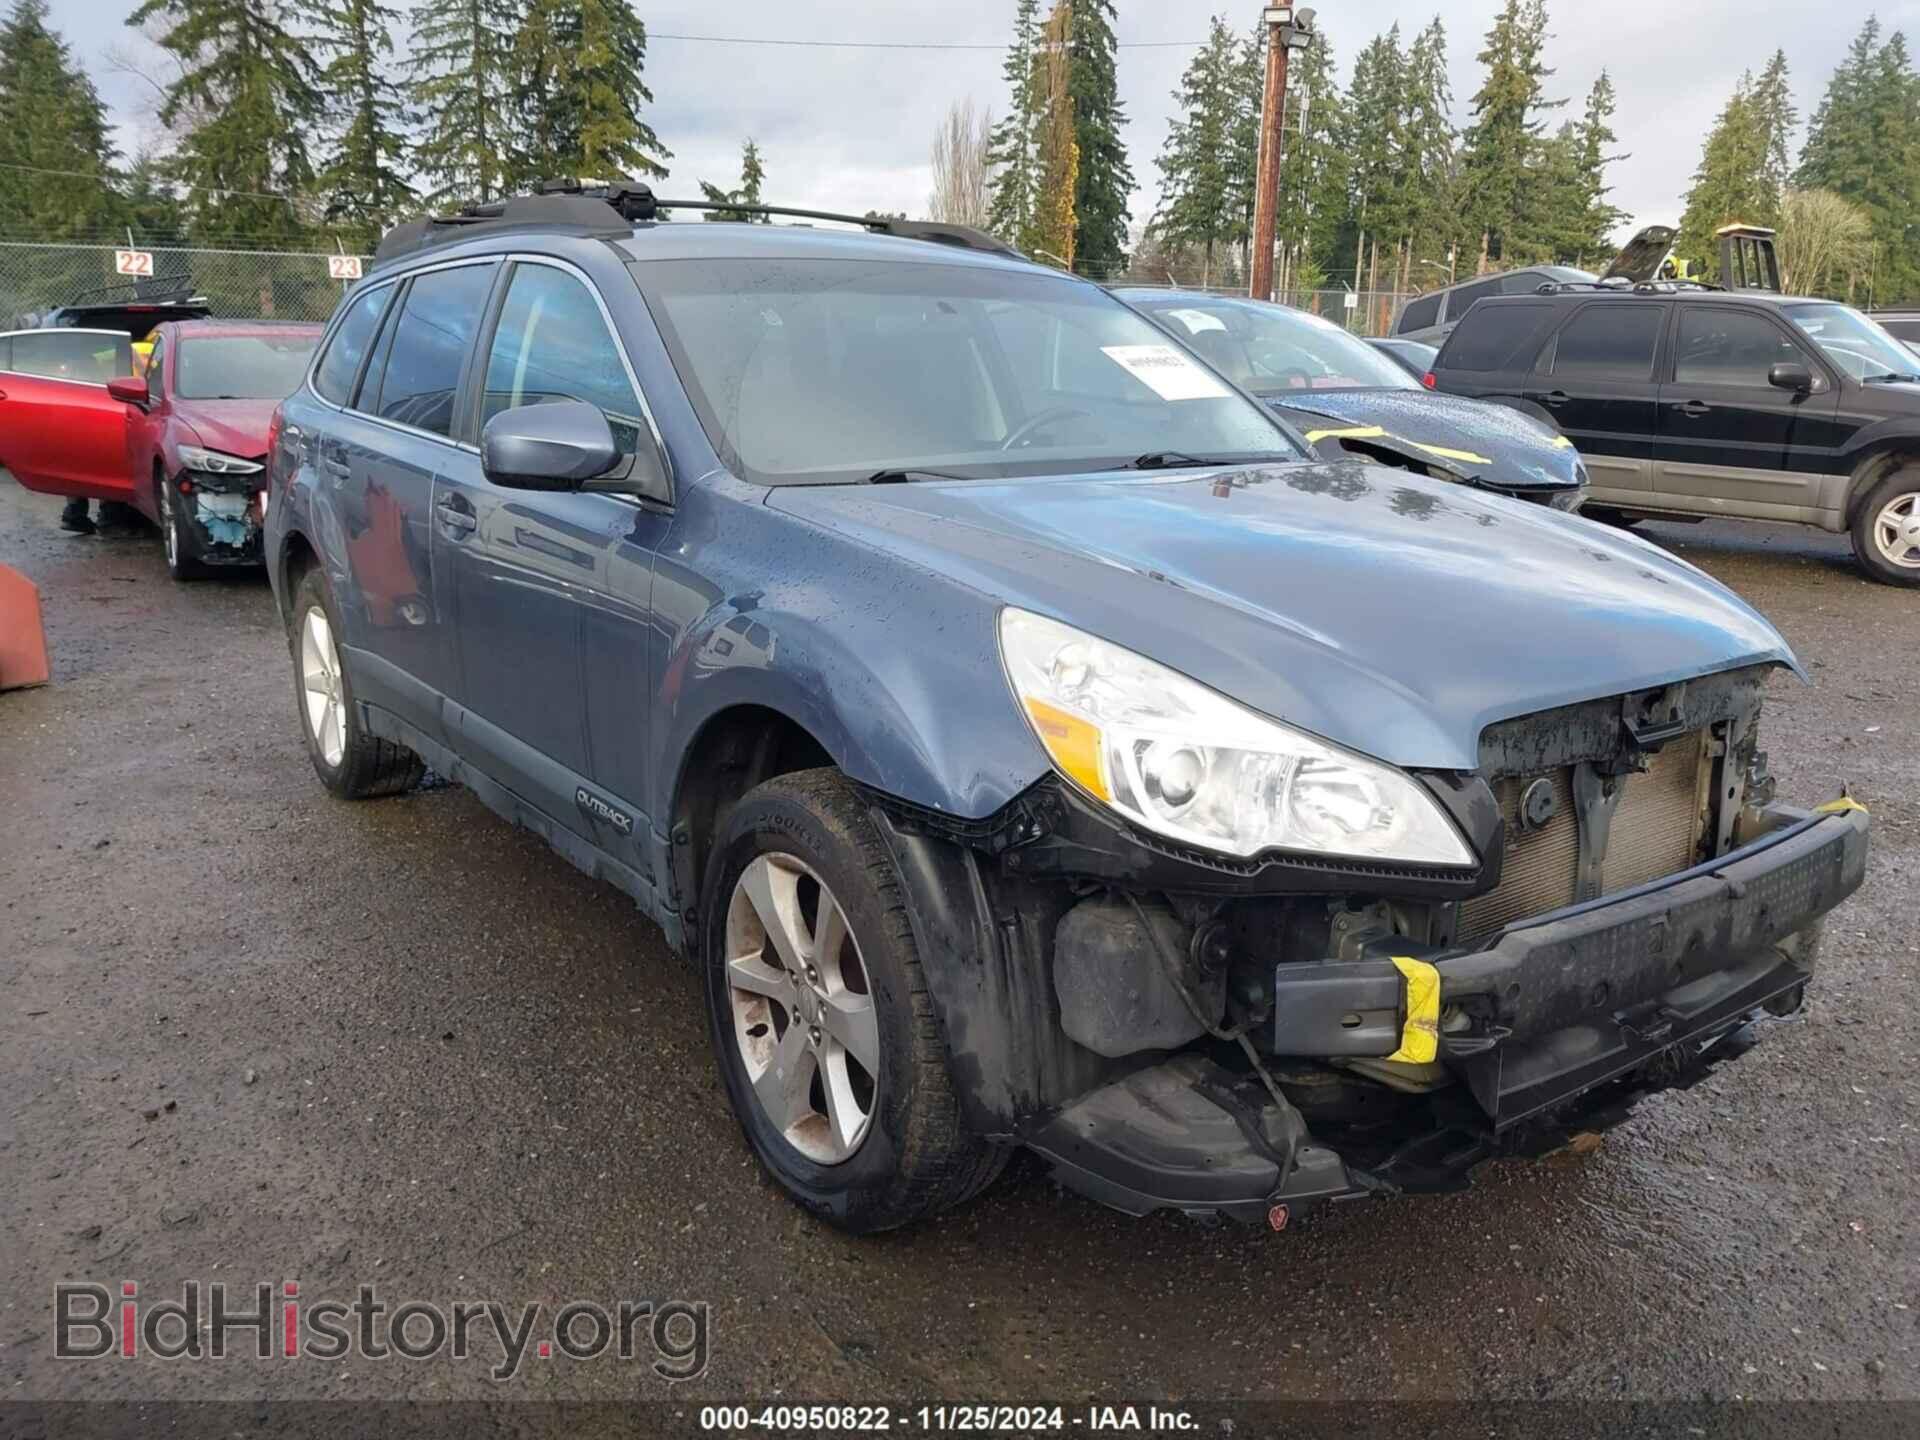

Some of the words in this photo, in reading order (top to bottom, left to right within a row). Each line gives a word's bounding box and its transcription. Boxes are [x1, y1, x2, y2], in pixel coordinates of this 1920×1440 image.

[120, 252, 150, 273] 22
[332, 258, 358, 276] 23
[577, 790, 631, 832] OUTBACK
